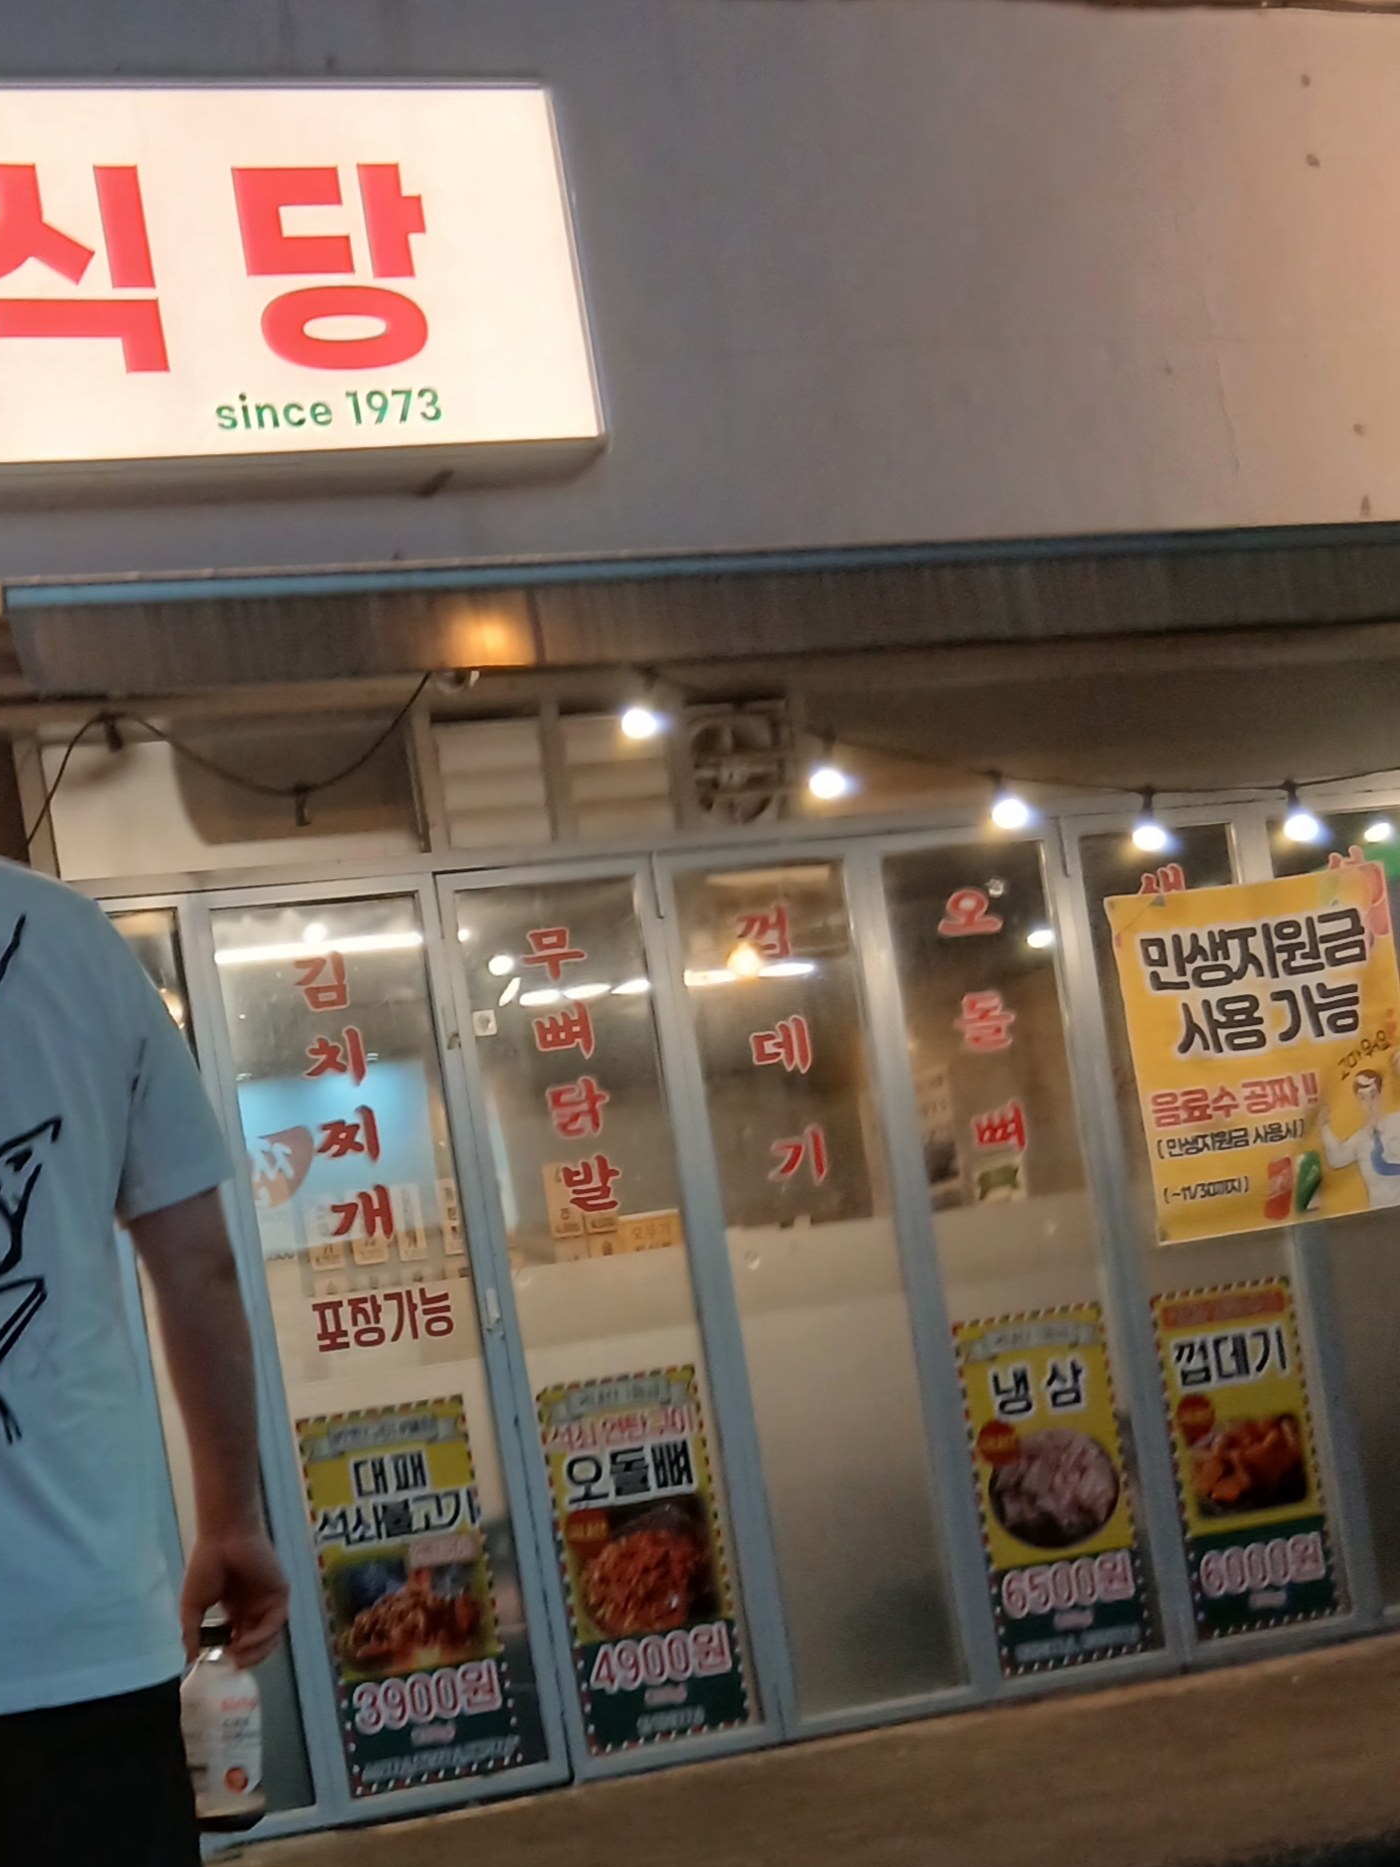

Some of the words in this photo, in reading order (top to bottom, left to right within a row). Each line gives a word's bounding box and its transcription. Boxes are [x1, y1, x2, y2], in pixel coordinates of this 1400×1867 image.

[215, 394, 333, 431] since
[346, 388, 443, 428] 1973
[1139, 908, 1367, 992] 민생지원금
[1178, 994, 1267, 1055] 사용
[1271, 983, 1360, 1042] 가능
[294, 951, 394, 1240] 김치찌개
[1151, 1086, 1239, 1128] 음료수
[1243, 1077, 1299, 1115] 공짜
[312, 1287, 454, 1352] 포장가능
[1174, 1326, 1287, 1387] 껍데기
[566, 1438, 693, 1505] 오돌뼈
[1004, 1552, 1131, 1616] 6500원
[1202, 1533, 1323, 1594] 6000원
[594, 1626, 727, 1690] 4900원
[357, 1663, 498, 1729] 3900원
